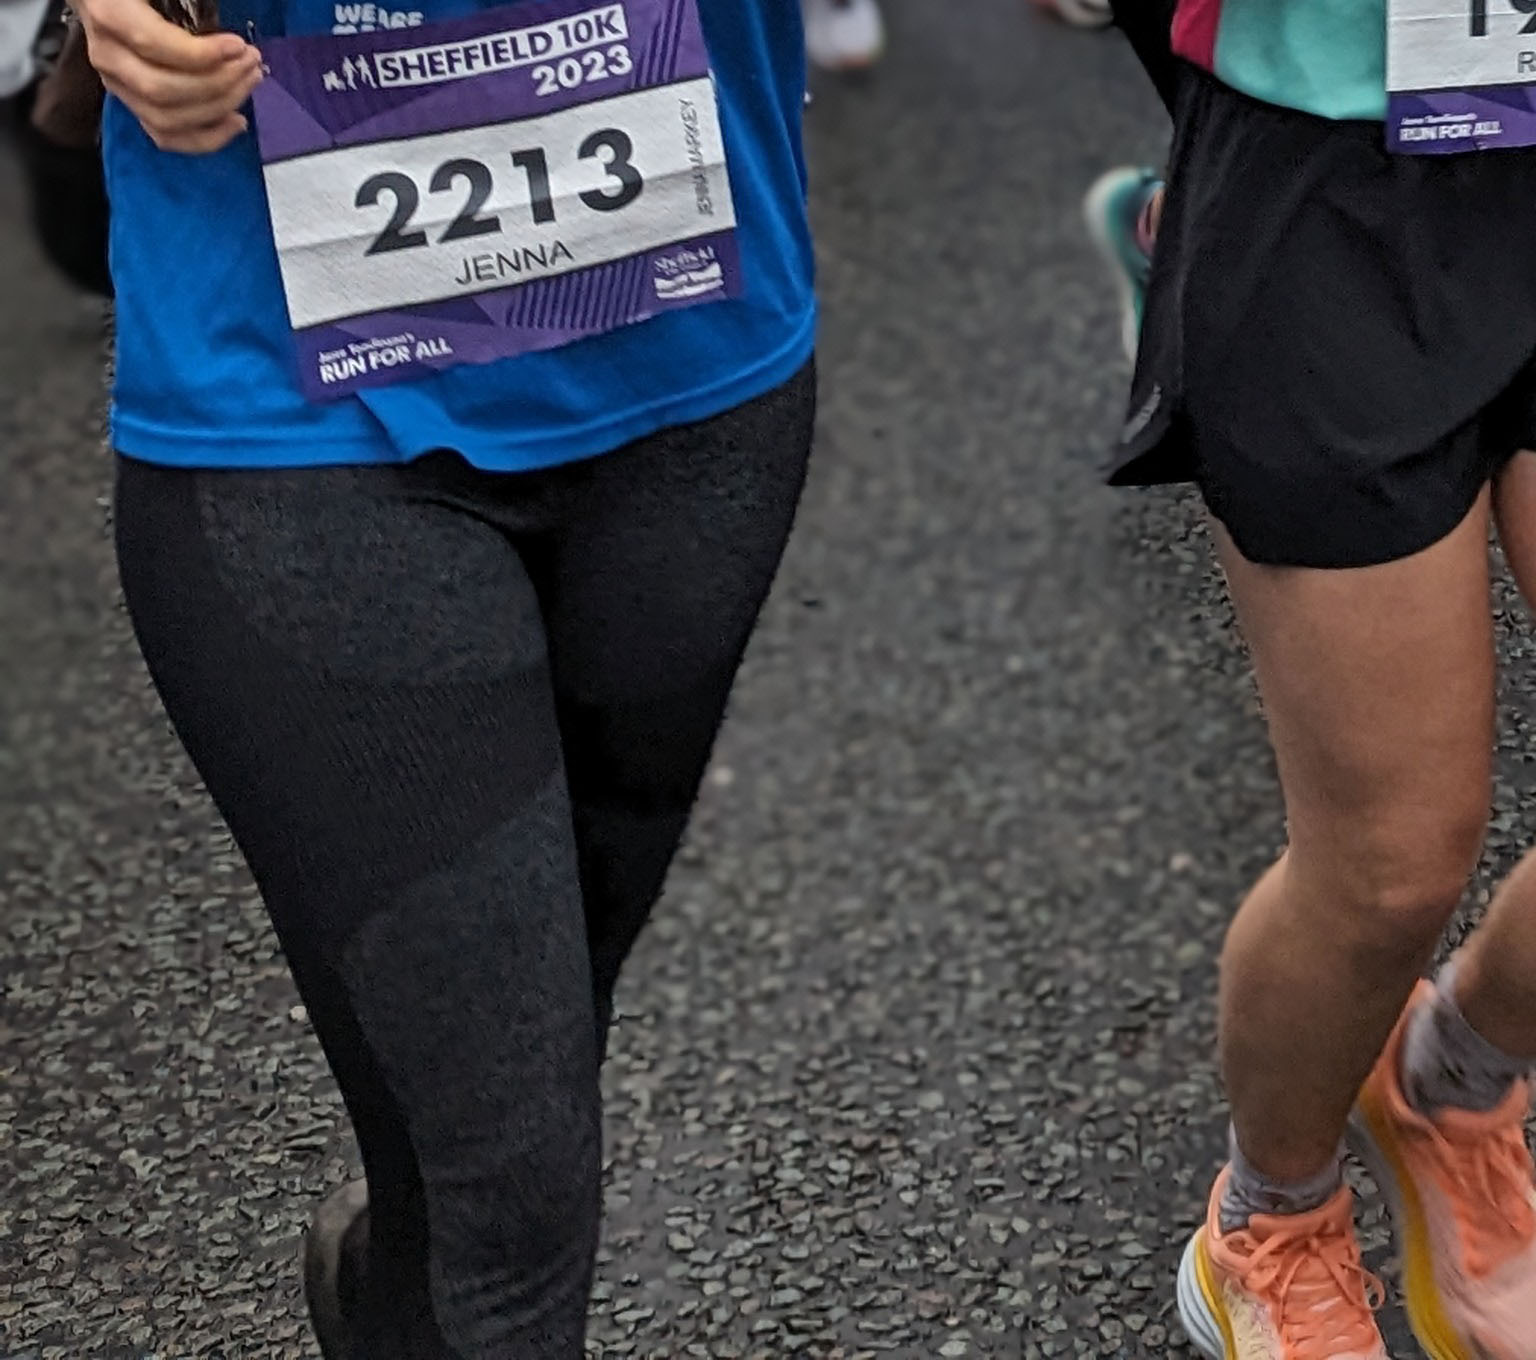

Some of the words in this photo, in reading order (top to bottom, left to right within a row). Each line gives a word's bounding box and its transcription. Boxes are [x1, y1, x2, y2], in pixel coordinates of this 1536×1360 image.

[380, 30, 554, 81] SHEFFIELD
[560, 7, 624, 48] 10K
[532, 43, 634, 97] 2023
[355, 128, 644, 257] 2213
[455, 240, 575, 285] JENNA
[319, 355, 367, 384] RUN
[368, 344, 412, 370] FOR
[415, 336, 454, 361] ALL
